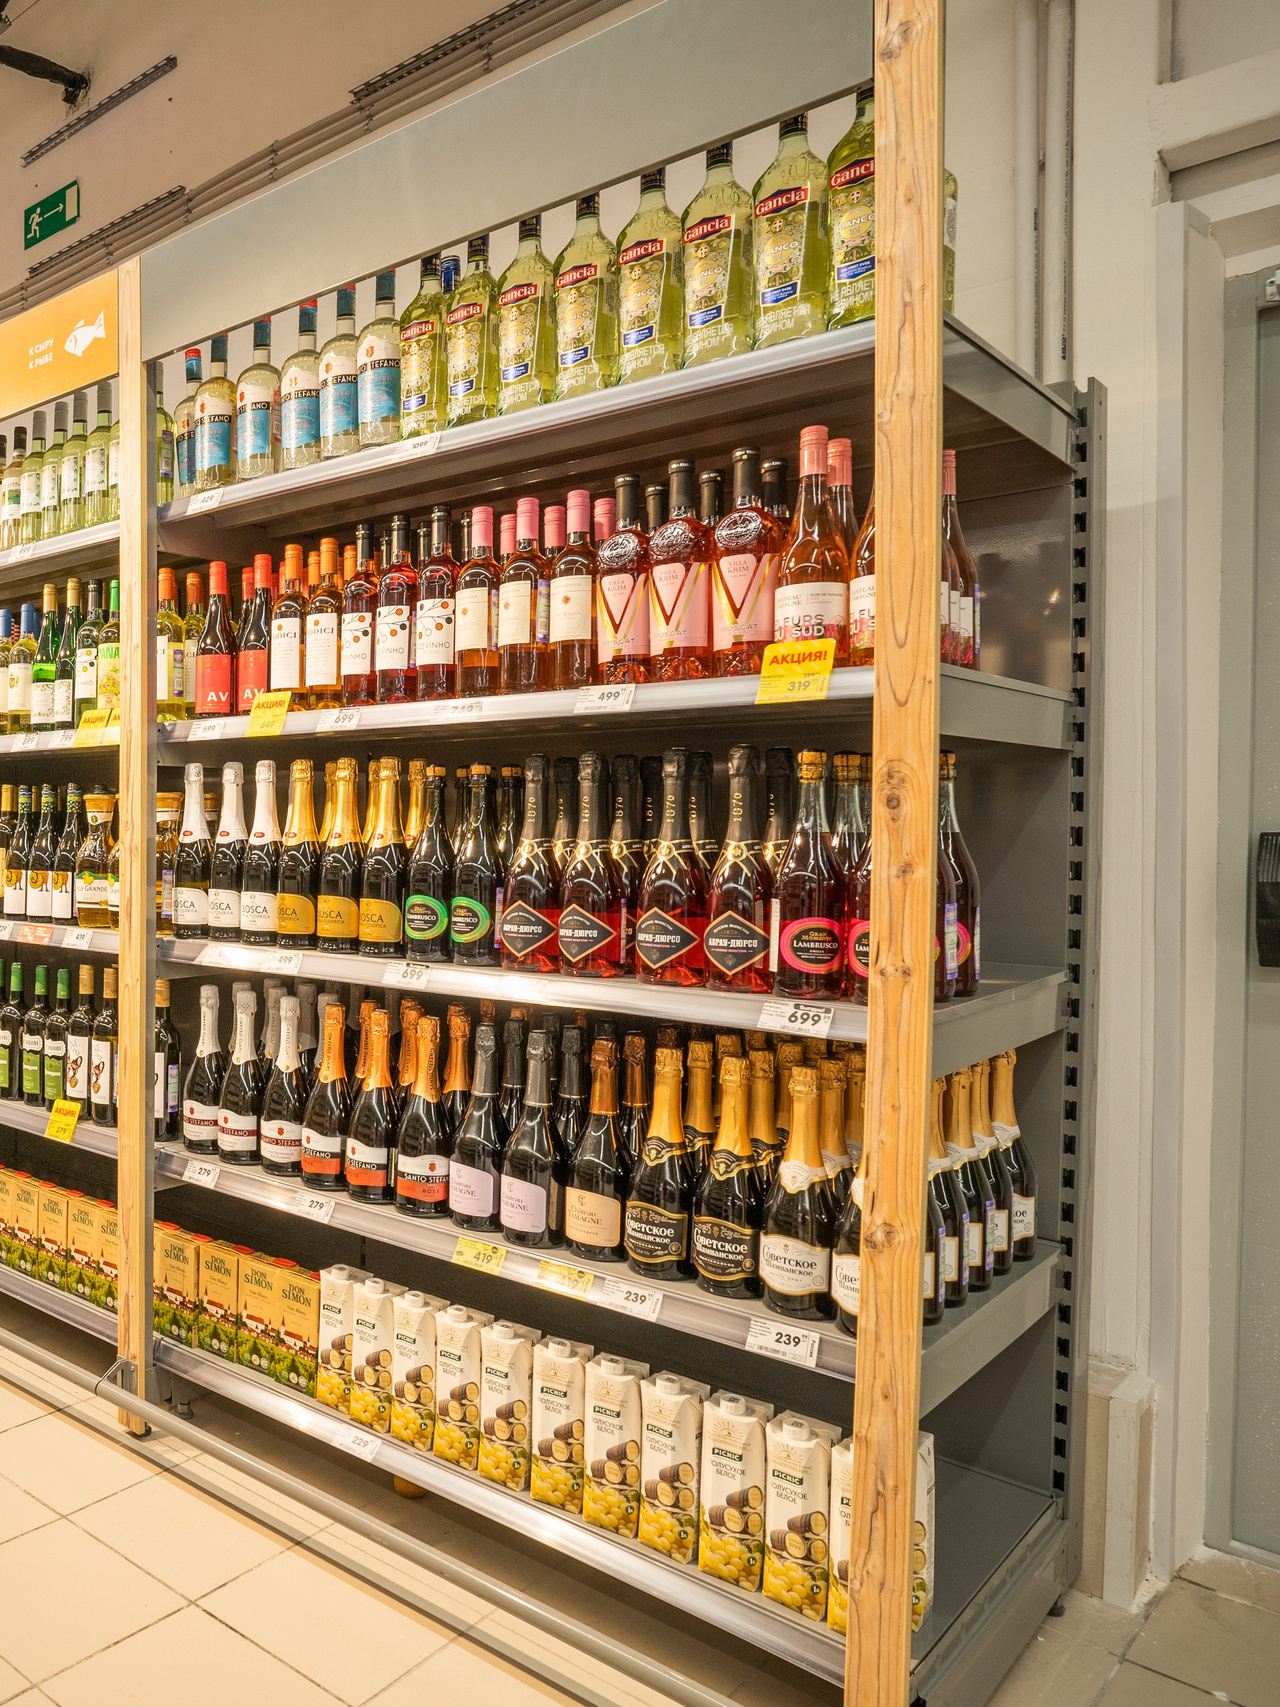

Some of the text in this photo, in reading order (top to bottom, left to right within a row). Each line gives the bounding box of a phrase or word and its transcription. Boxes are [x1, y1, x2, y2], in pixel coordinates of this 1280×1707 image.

[830, 160, 875, 188] Ganci
[755, 189, 806, 216] Gancia
[683, 217, 729, 241] Gancia
[619, 242, 661, 263] Gancia
[556, 266, 596, 287] Gancia
[840, 278, 875, 297] ЯВЛЯЕТ
[498, 286, 535, 306] Gancia
[447, 305, 481, 323] Gancia
[400, 322, 432, 341] Gancia
[28, 338, 54, 357] К СЫРУ
[28, 352, 53, 370] К РЫБЕ
[412, 440, 428, 450] 1099
[727, 565, 749, 574] KRIM
[659, 574, 678, 583] KRIM
[607, 584, 626, 592] KRIM
[720, 623, 758, 632] MUSCAT
[791, 625, 825, 637] SUD
[602, 637, 635, 646] MUSCAT
[769, 650, 827, 666] АКЦИЯ!
[787, 680, 811, 691] 319
[207, 692, 229, 702] AV
[598, 691, 621, 702] 499
[254, 700, 286, 710] АКЦИЯ!
[82, 716, 106, 724] АКЦИЯ!
[260, 720, 275, 729] 649
[334, 713, 354, 724] 699
[203, 724, 216, 733] 699
[60, 734, 73, 743] 799
[528, 796, 536, 823] 1870
[582, 795, 590, 822] 1870
[616, 796, 624, 823] 1870
[666, 794, 676, 823] 1870
[733, 792, 743, 822] 1870
[85, 884, 108, 892] GRANDE
[242, 904, 268, 914] BOSCA
[502, 924, 542, 934] АБРАУ-ДЮРСО
[637, 933, 680, 943] АБРАУ-ДЮРСО
[708, 938, 758, 948] АБРАУ-ДЮРСО
[793, 940, 838, 949] LAMBRUSCO
[277, 955, 293, 965] 499
[401, 969, 424, 980] 699
[788, 1011, 821, 1026] 699
[54, 1107, 76, 1117] АКЦИЯ!
[190, 1117, 214, 1127] STEFANO
[56, 1127, 67, 1135] 279
[224, 1128, 248, 1137] STEFANO
[305, 1148, 331, 1159] STEFANO
[351, 1160, 377, 1171] STEFANO
[198, 1167, 211, 1177] 279
[404, 1173, 427, 1182] SANTO
[21, 1189, 32, 1198] DON
[16, 1194, 35, 1206] SIMON
[47, 1199, 59, 1209] DON
[308, 1199, 324, 1210] 279
[42, 1203, 64, 1217] SIMON
[77, 1208, 89, 1218] DON
[571, 1204, 597, 1217] Château
[72, 1213, 94, 1228] SIMON
[568, 1210, 603, 1225] TAMAGNE
[626, 1212, 675, 1237] Советское
[627, 1227, 671, 1245] Шампанское
[694, 1227, 748, 1254] Советское
[170, 1244, 184, 1255] DON
[696, 1244, 744, 1261] Шампанское
[164, 1249, 189, 1265] SIMON
[211, 1255, 226, 1266] DON
[474, 1252, 493, 1264] 419
[763, 1245, 817, 1270] Советское
[205, 1260, 232, 1277] SIMON
[251, 1268, 267, 1280] DON
[765, 1261, 813, 1277] Шампанское
[244, 1273, 273, 1291] SIMON
[289, 1283, 305, 1295] DON
[282, 1289, 312, 1307] SIMON
[624, 1291, 647, 1305] 239
[774, 1332, 801, 1347] 239
[487, 1367, 508, 1378] PICNIC
[542, 1387, 566, 1398] PICNIC
[544, 1405, 562, 1415] БЕЛОЕ
[595, 1406, 619, 1417] PICNIC
[596, 1425, 615, 1436] БЕЛОЕ
[648, 1424, 671, 1437] PICNIC
[351, 1436, 369, 1448] 229
[650, 1445, 668, 1456] БЕЛОЕ
[713, 1448, 740, 1461] PICNIC
[715, 1469, 737, 1481] БЕЛОЕ
[774, 1470, 800, 1484] PICNIC
[776, 1491, 797, 1504] БЕЛОЕ
